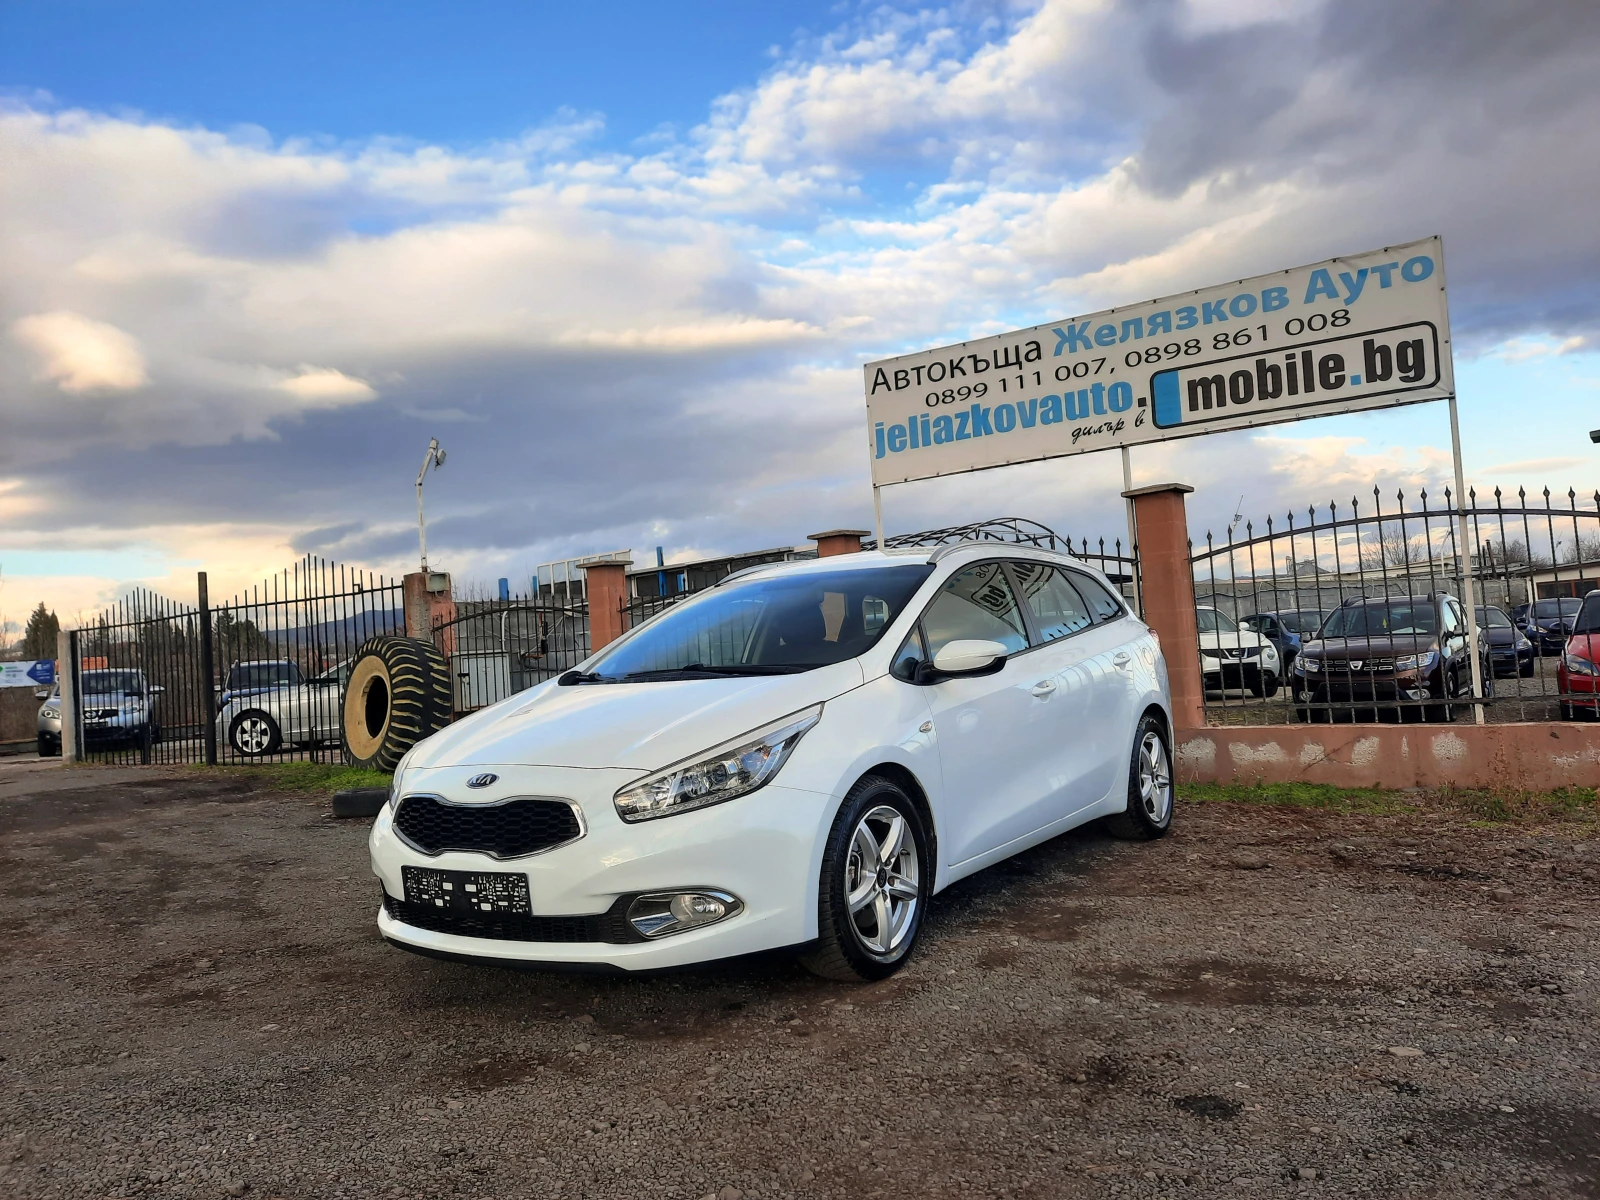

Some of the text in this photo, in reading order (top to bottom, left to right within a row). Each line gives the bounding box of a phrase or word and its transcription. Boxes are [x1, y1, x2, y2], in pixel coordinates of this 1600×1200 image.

[871, 254, 1435, 395] Автокъща Желязков Ауто
[925, 308, 1352, 407] 0899 111 007, 0898 861 008
[1187, 338, 1426, 412] mobile.bg
[1071, 417, 1126, 444] дилър
[469, 774, 493, 785] KIA
